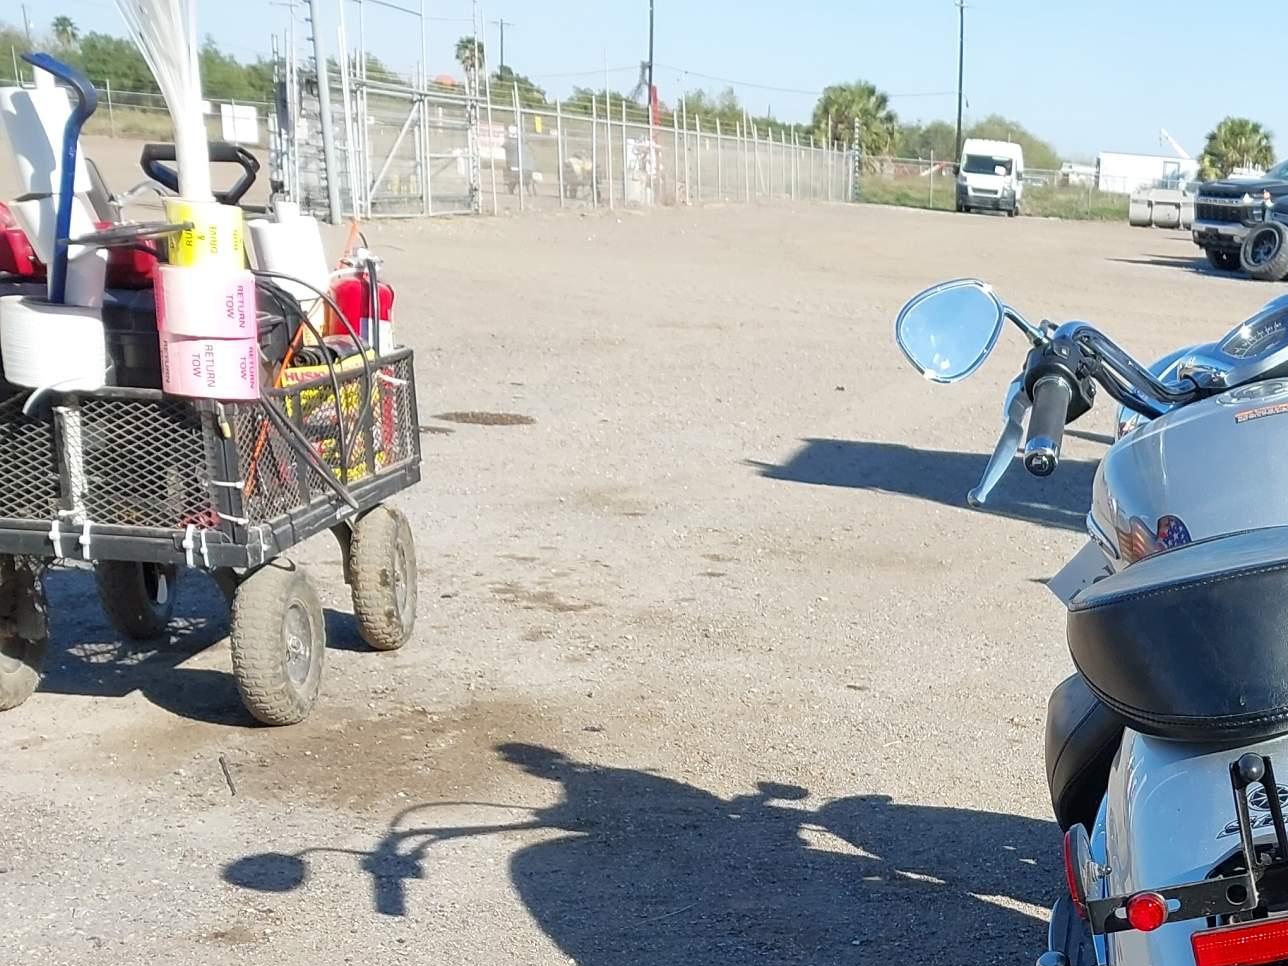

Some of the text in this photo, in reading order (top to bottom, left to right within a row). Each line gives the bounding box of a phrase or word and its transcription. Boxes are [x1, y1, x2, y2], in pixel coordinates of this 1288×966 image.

[225, 294, 235, 319] TOW
[237, 285, 246, 329] RETURN
[191, 351, 202, 378] TOW
[204, 344, 216, 388] RETURN
[239, 356, 248, 380] TOW
[248, 346, 256, 389] RETURN
